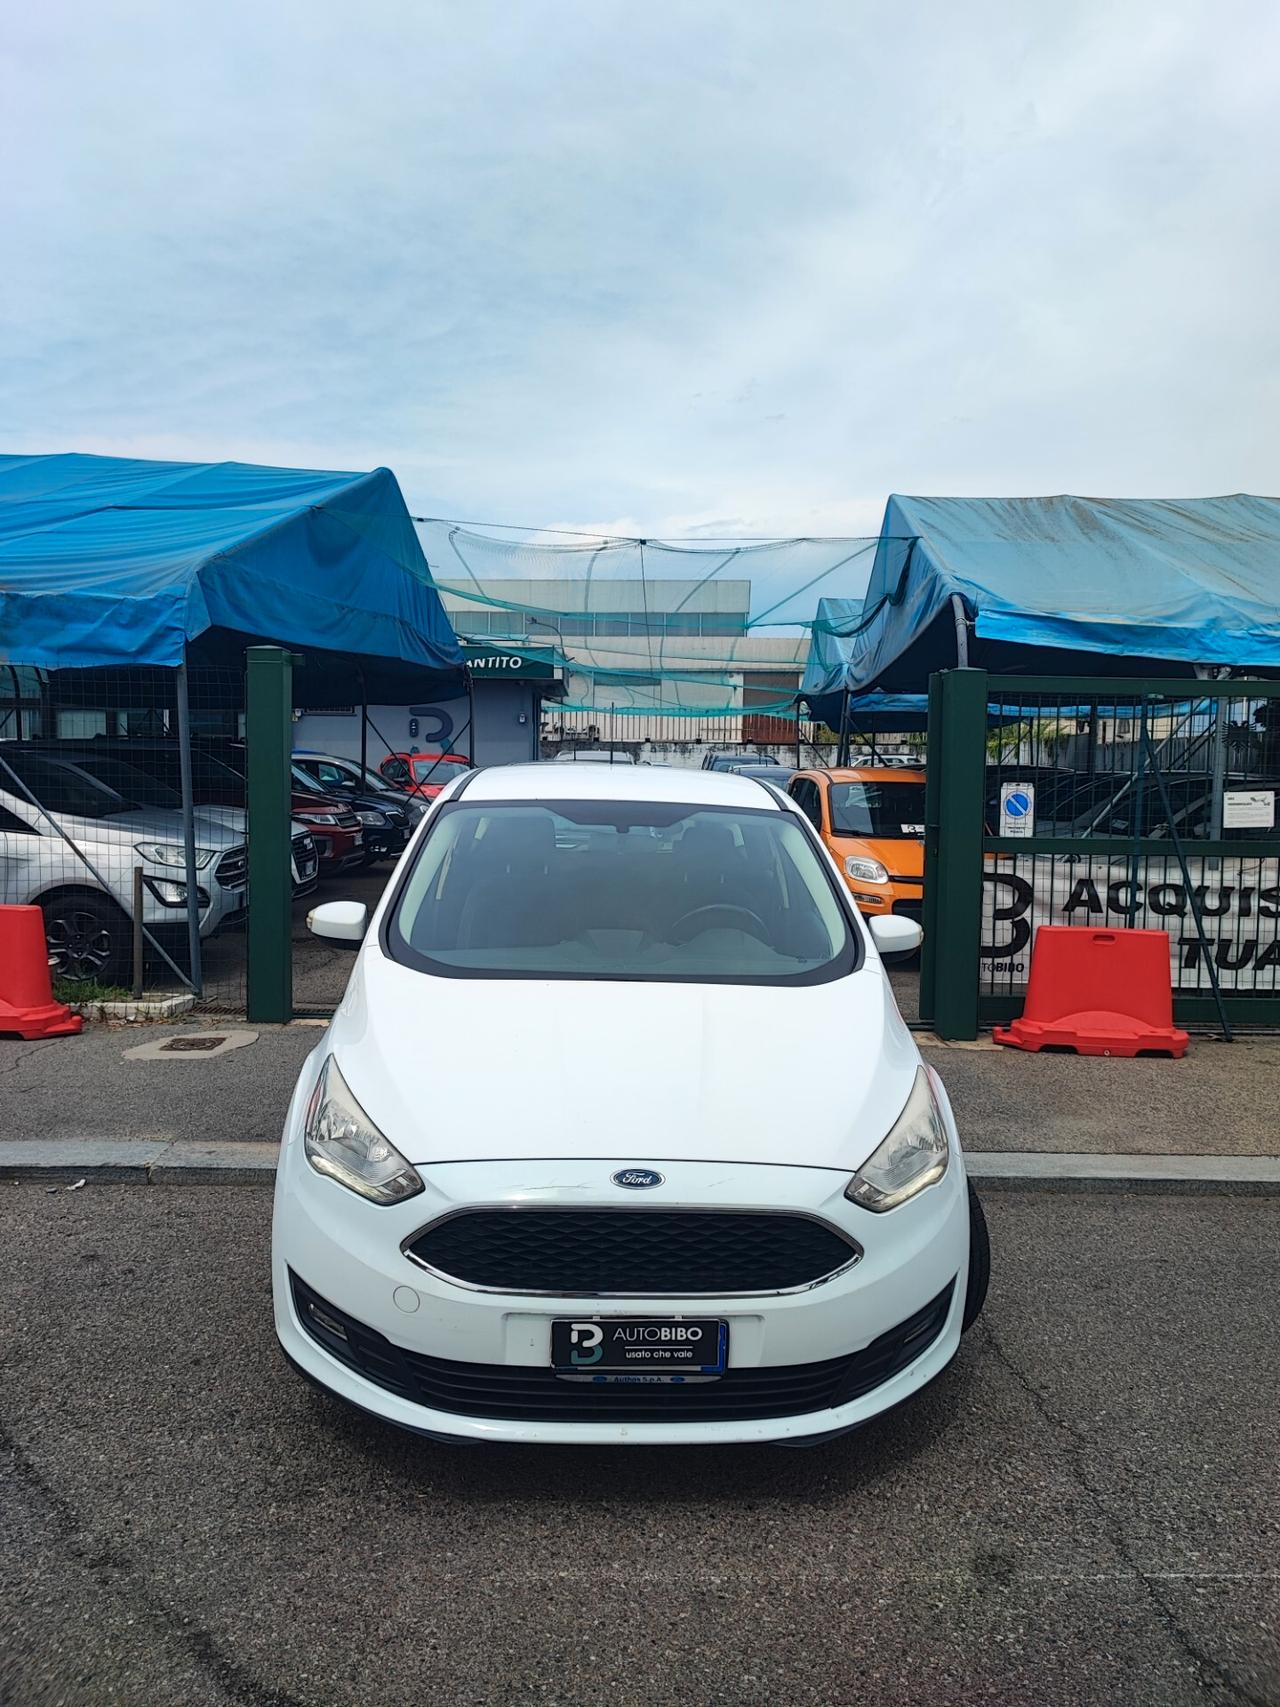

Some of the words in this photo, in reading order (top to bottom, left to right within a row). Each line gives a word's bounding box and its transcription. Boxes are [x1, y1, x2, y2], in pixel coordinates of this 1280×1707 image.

[466, 656, 522, 668] ANTITO
[1062, 878, 1280, 918] ACQUIS
[982, 962, 1025, 973] TOBIBO
[622, 1172, 653, 1184] Ford
[612, 1327, 703, 1341] AUTOBIBO
[626, 1350, 652, 1359] usato
[653, 1350, 671, 1359] che
[673, 1350, 693, 1359] vale
